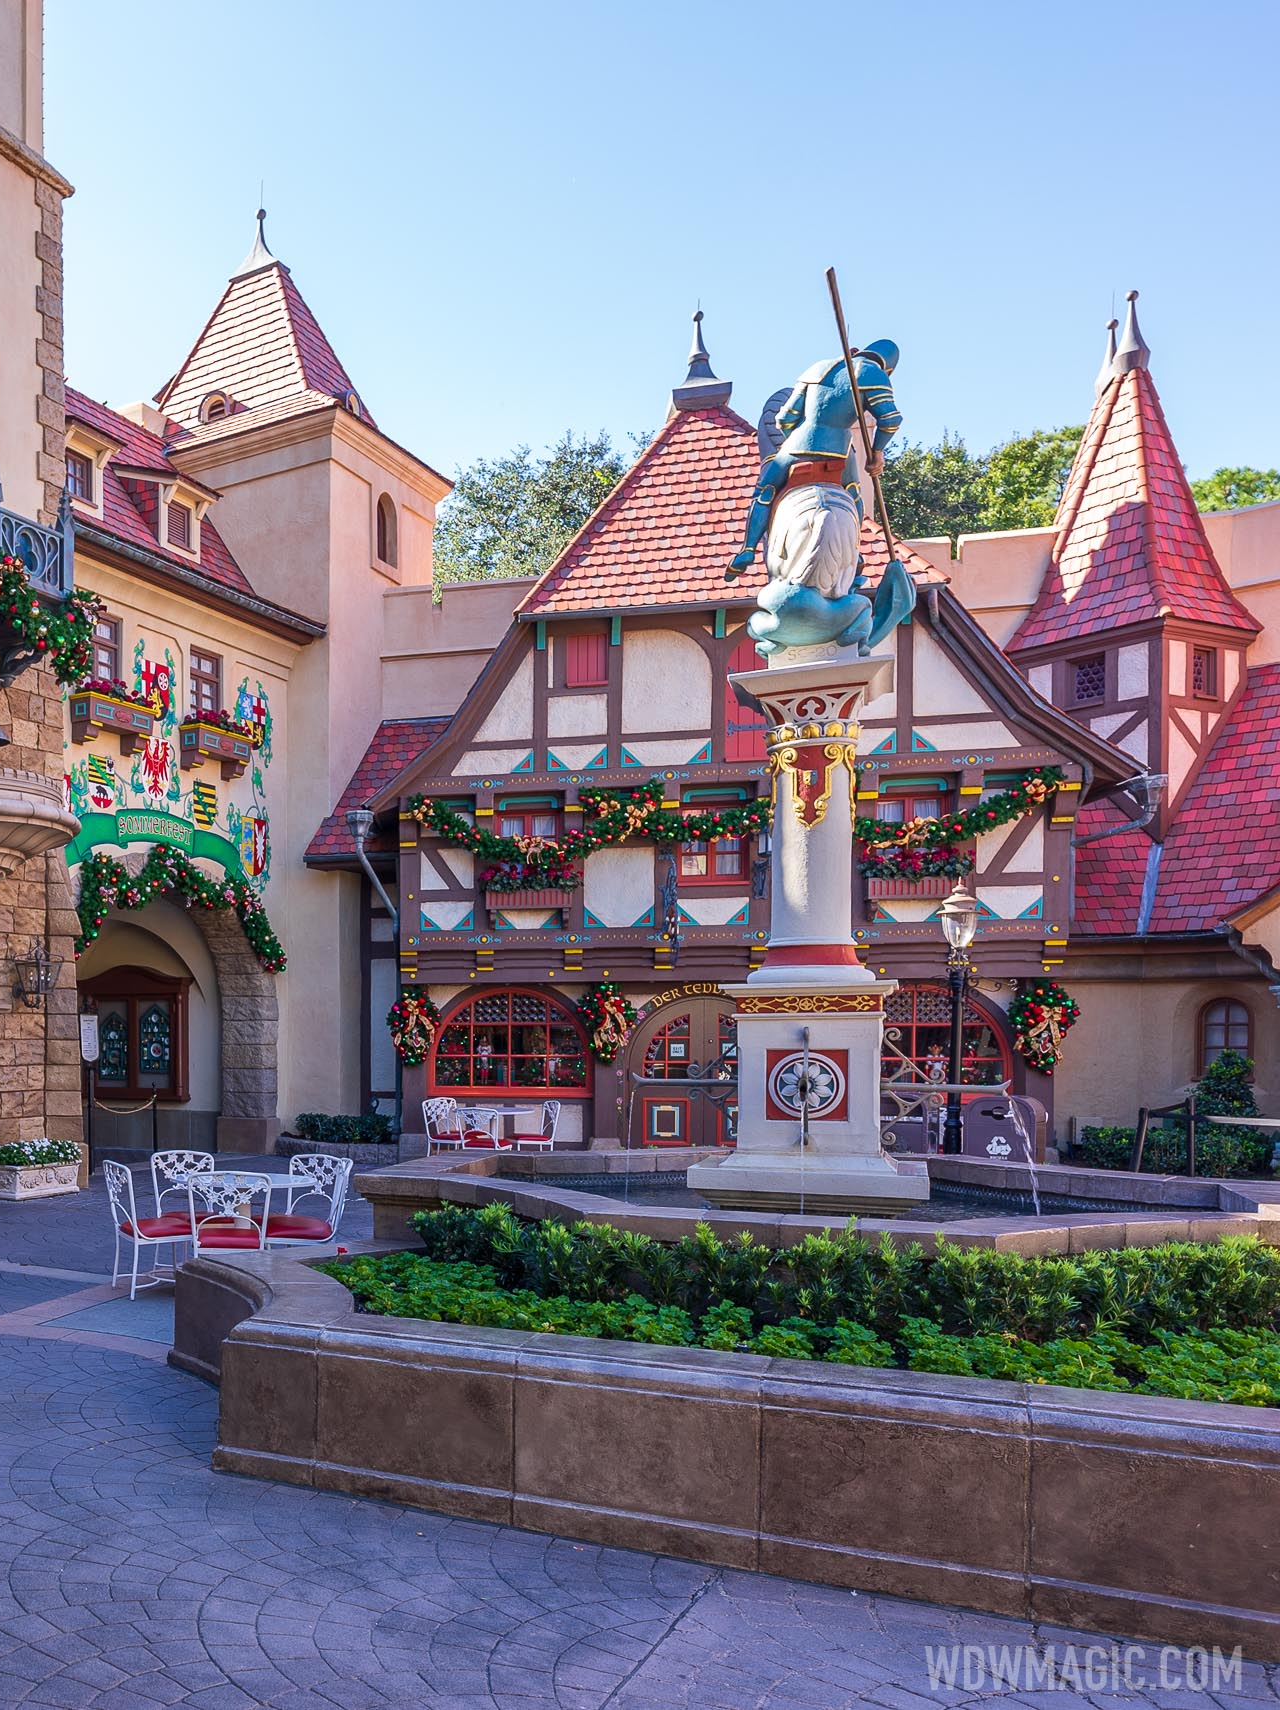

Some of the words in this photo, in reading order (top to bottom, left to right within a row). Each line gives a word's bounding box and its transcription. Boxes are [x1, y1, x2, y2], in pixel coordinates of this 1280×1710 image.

[119, 816, 192, 845] SOMMERFEST
[652, 989, 681, 1007] DER
[684, 983, 726, 995] TEDD
